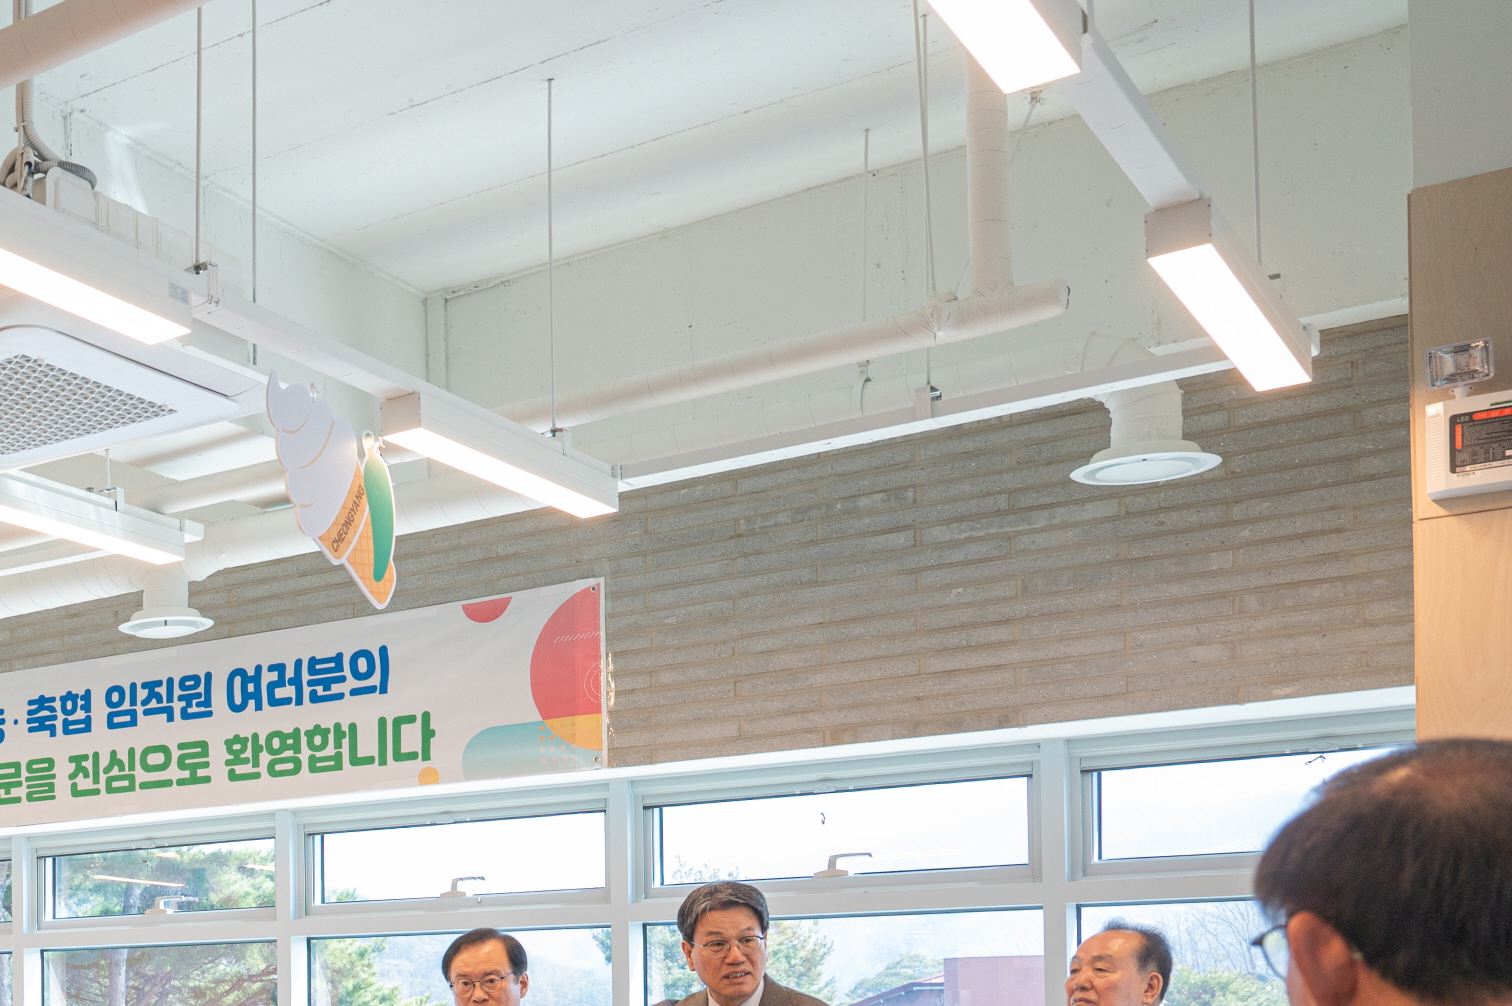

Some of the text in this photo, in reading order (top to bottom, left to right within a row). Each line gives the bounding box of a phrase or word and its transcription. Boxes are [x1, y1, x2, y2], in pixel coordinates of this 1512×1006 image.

[1456, 415, 1470, 423] LED
[331, 484, 365, 553] CHEONGYANG
[104, 671, 214, 730] 임직원
[226, 645, 390, 714] 여러분의
[68, 739, 212, 798] 진심으로
[224, 711, 436, 783] 환영합니다
